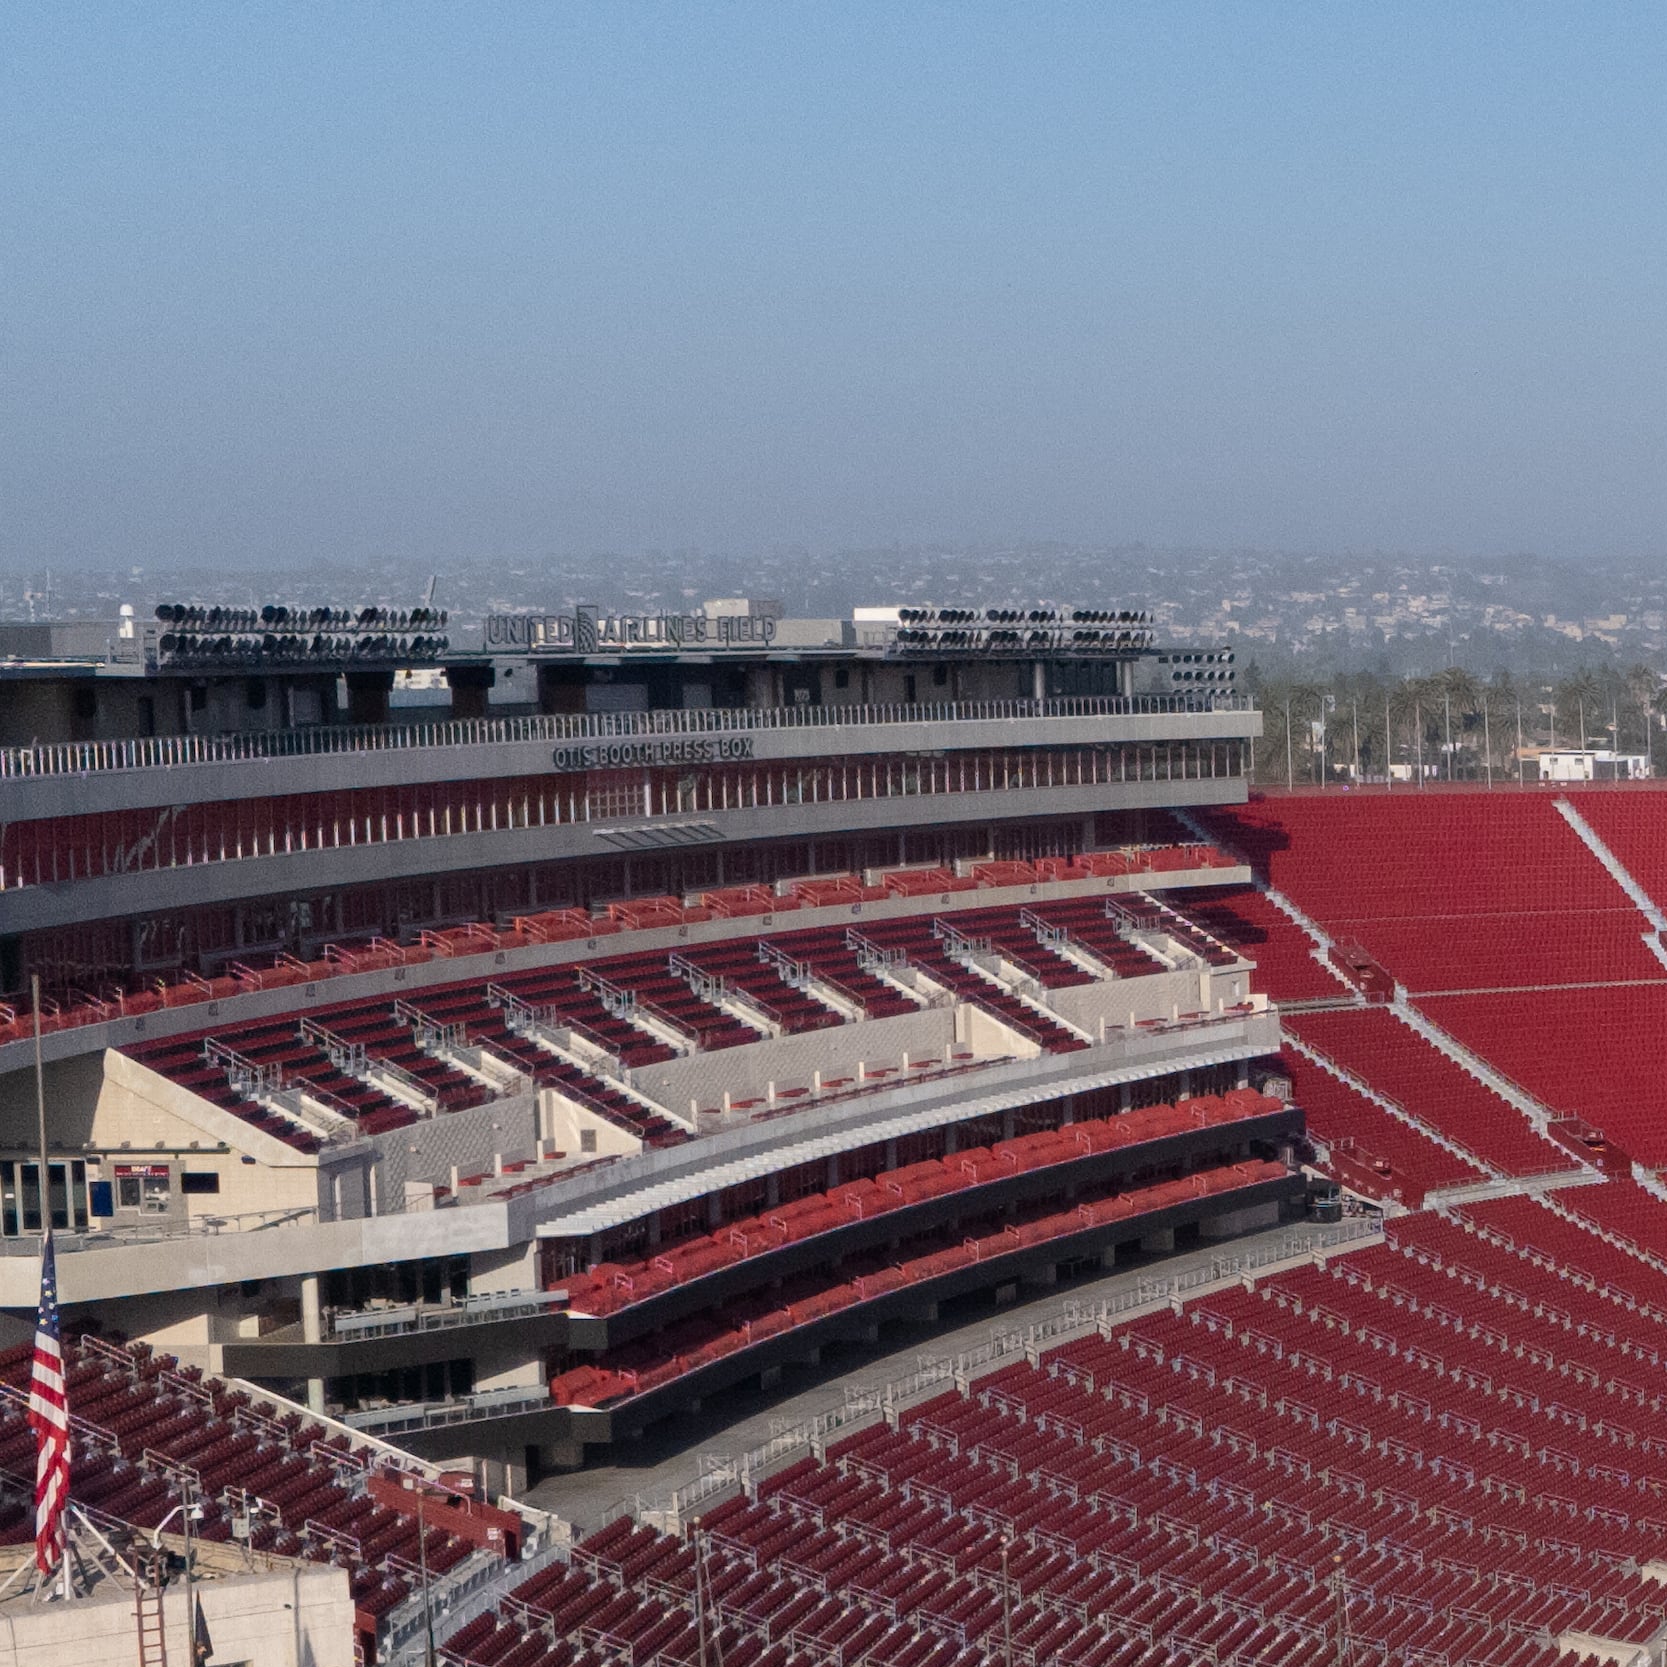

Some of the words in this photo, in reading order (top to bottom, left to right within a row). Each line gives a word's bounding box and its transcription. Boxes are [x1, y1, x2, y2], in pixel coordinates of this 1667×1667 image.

[487, 615, 574, 644] UNITED
[600, 614, 707, 643] AIRLINES
[717, 615, 777, 642] FIELD
[554, 747, 594, 768] OTIS
[599, 744, 656, 765] BOOTH
[662, 741, 714, 760] PRESS
[720, 737, 754, 758] BOX
